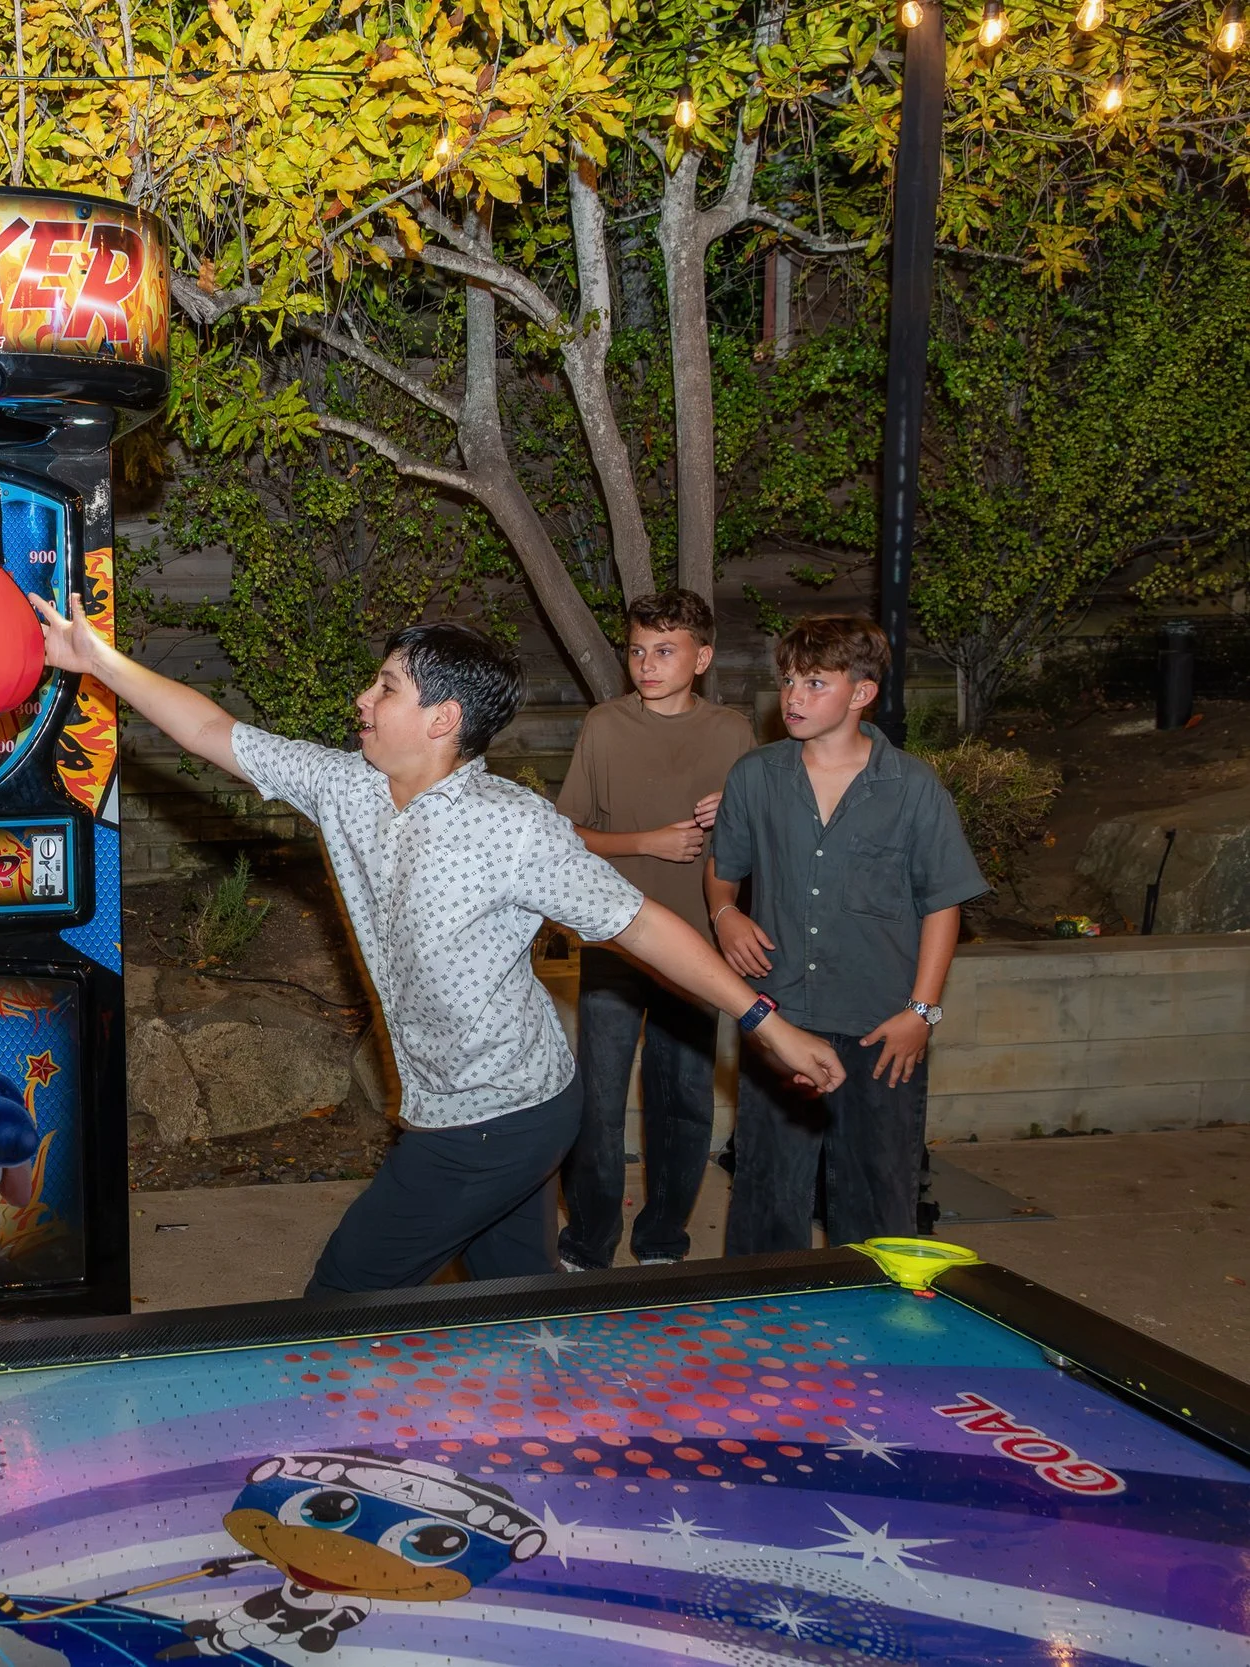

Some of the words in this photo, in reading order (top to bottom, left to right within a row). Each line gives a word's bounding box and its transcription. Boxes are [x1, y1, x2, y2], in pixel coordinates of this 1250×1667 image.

[29, 550, 57, 564] 900
[15, 702, 43, 715] 300
[931, 1392, 1127, 1496] GOAL
